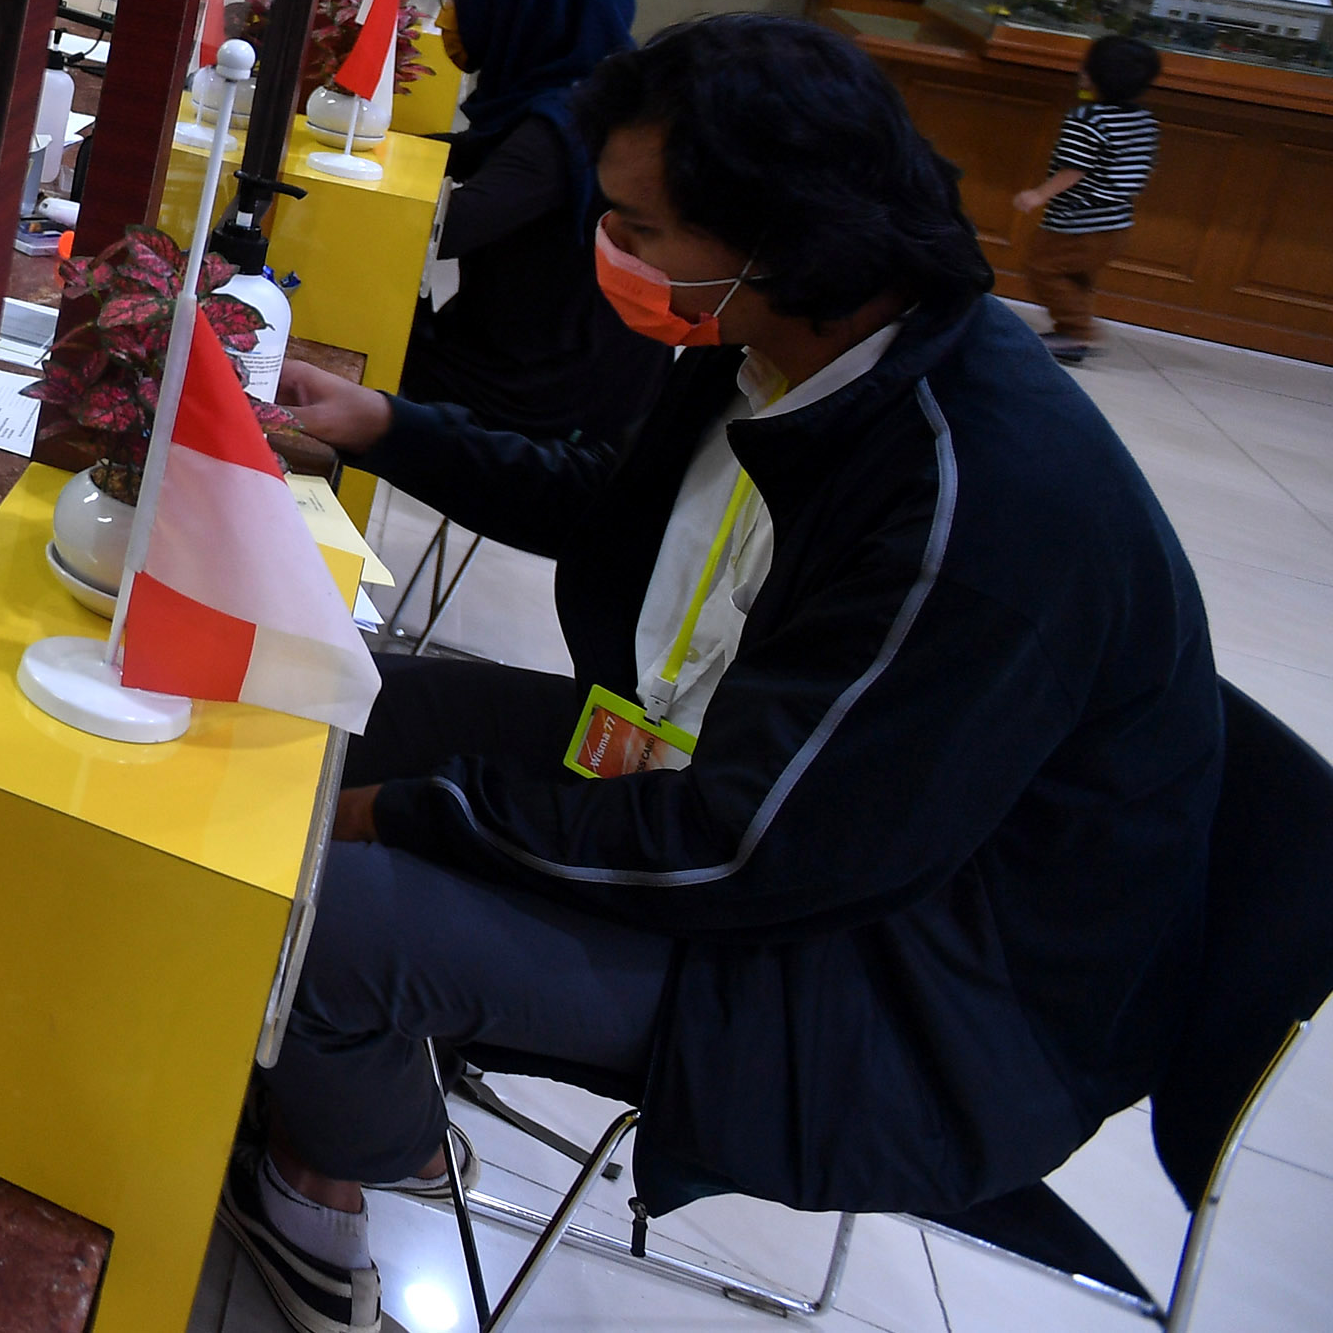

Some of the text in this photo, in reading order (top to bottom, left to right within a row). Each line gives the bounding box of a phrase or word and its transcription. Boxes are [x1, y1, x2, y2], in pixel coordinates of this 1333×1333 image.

[590, 715, 617, 768] Wisma 77
[642, 737, 655, 761] CARD
